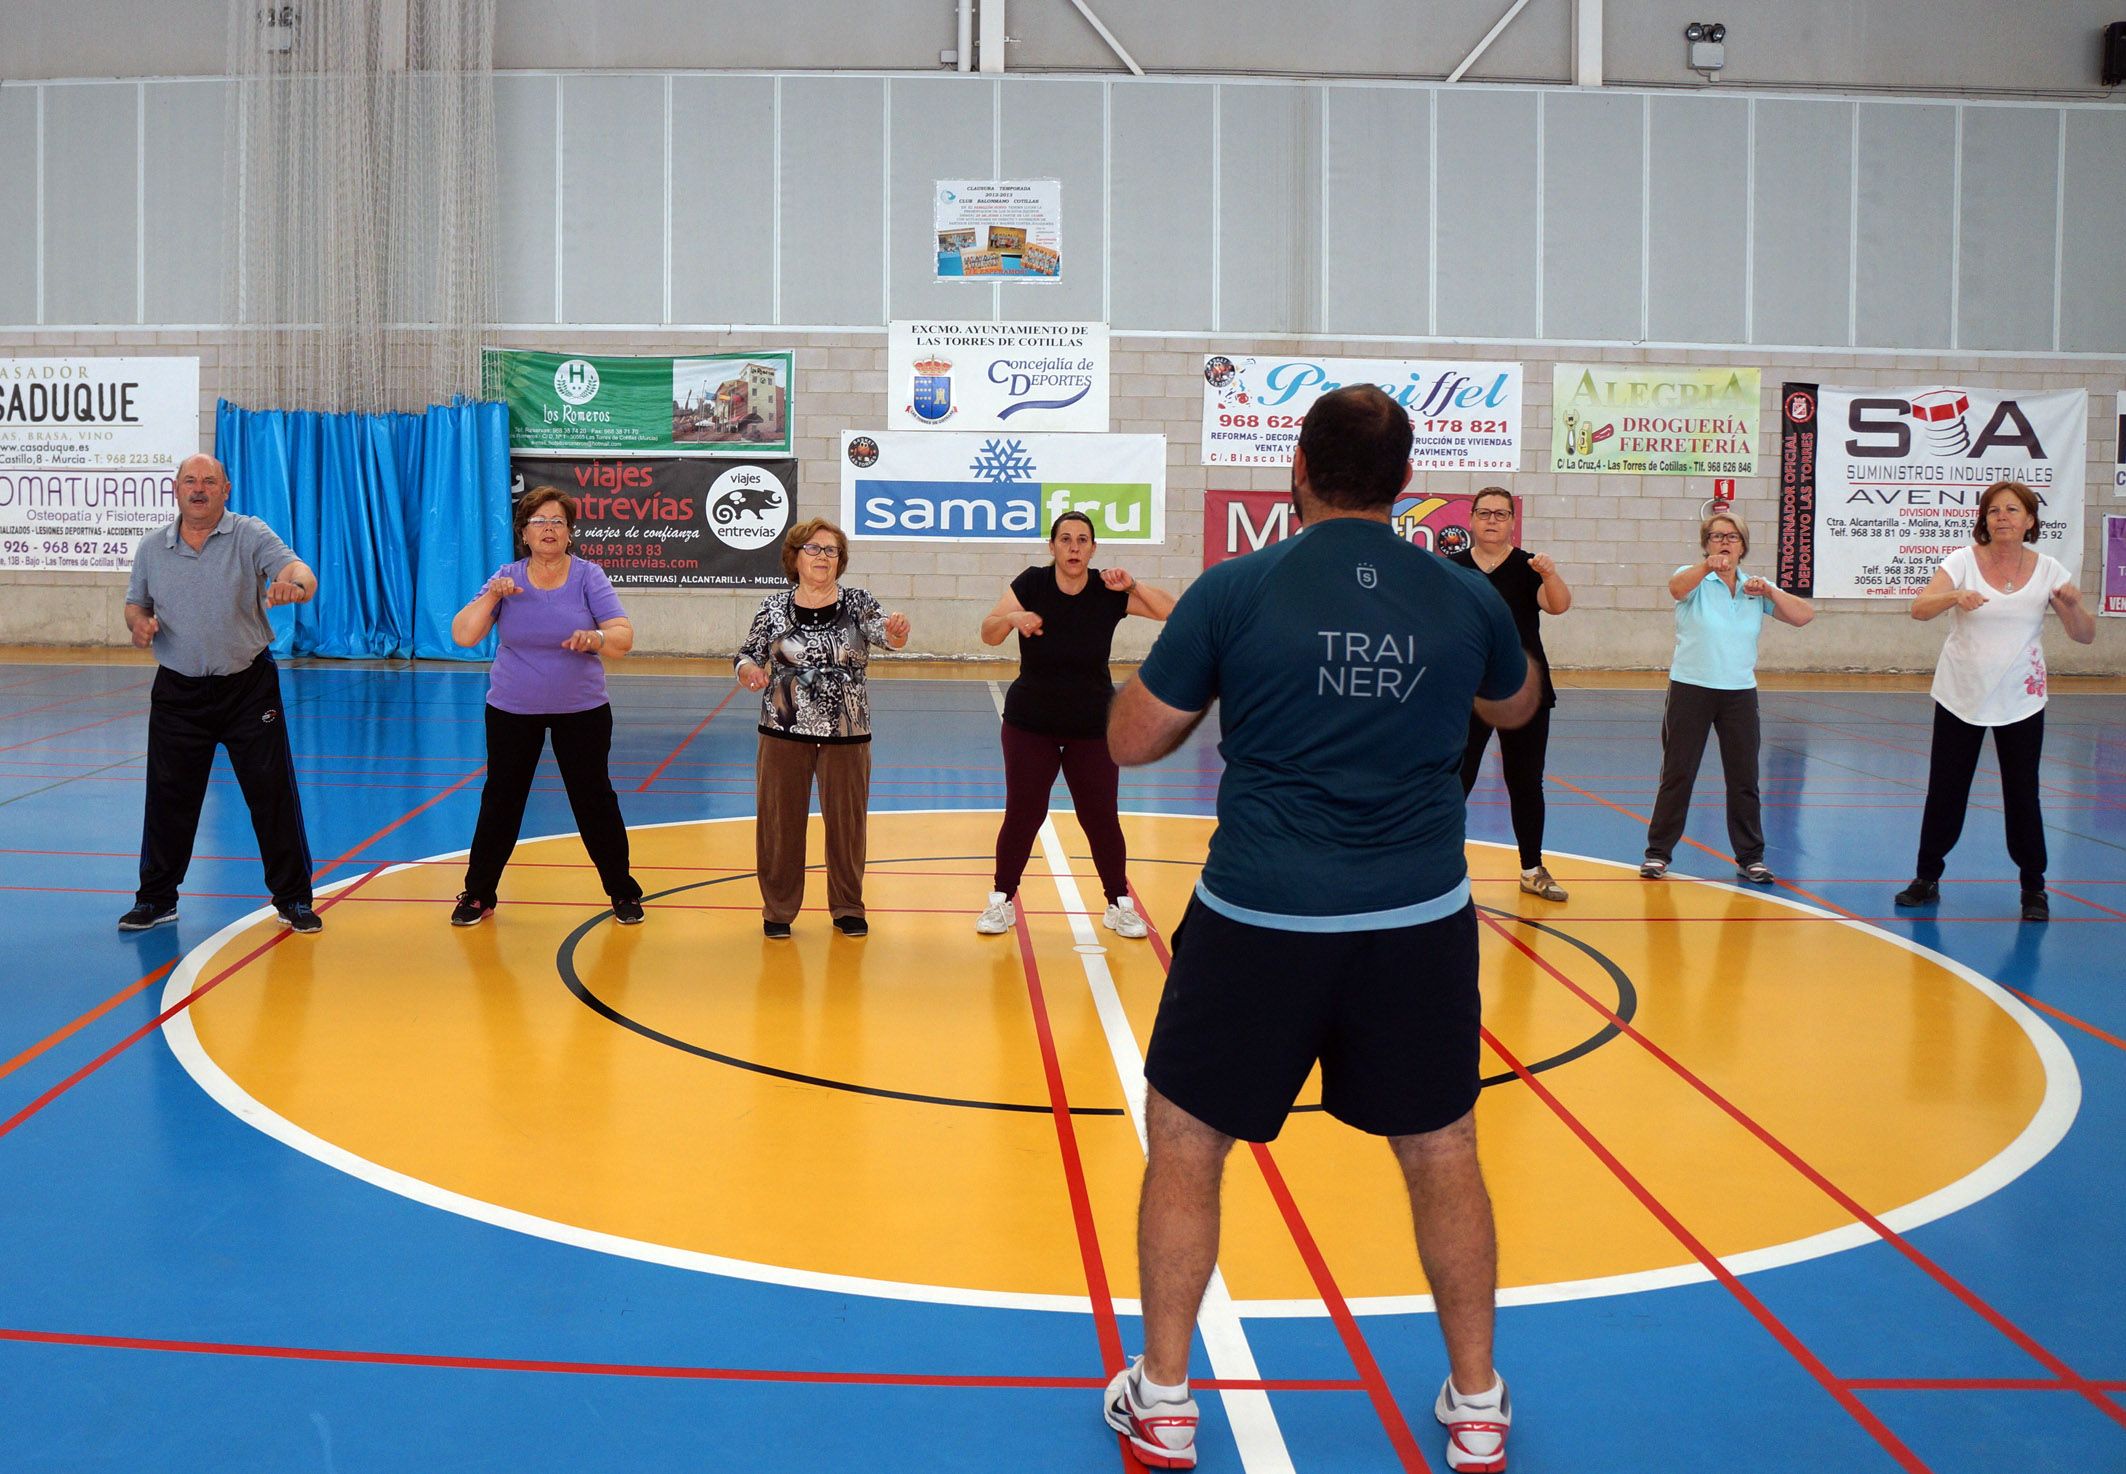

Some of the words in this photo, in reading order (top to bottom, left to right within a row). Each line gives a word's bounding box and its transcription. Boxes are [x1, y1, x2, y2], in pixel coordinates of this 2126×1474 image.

[911, 325, 962, 334] EXCMO.
[965, 325, 1069, 335] AYUNTAMIENTO
[1071, 326, 1089, 335] DE
[916, 336, 941, 346] LAS
[944, 337, 995, 346] TORRES
[998, 337, 1015, 347] DE
[1018, 338, 1083, 347] COTILLAS
[569, 364, 585, 383] H
[987, 357, 1073, 384] Concejalía
[1077, 358, 1094, 371] de
[1008, 373, 1093, 396] DEPORTES
[1572, 368, 1748, 408] ALEGRIA
[0, 382, 139, 422] ADUQUE
[543, 404, 559, 424] Los
[562, 404, 610, 424] Romeros
[1219, 414, 1259, 428] 968
[1424, 419, 1462, 432] 178
[1470, 420, 1507, 433] 821
[1622, 415, 1748, 434] DROGUERÍA
[28, 432, 72, 441] BRASA,
[80, 432, 113, 441] VINO
[1211, 432, 1257, 441] REFORMAS
[1265, 433, 1299, 441] DECORA
[1415, 435, 1453, 445] RUCCIÓN
[1454, 437, 1466, 445] DE
[1467, 438, 1513, 446] VIVIENDAS
[1255, 444, 1284, 452] VENTA
[1285, 444, 1291, 452] Y
[1414, 448, 1468, 456] PAVIMENTOS
[1619, 434, 1750, 454] FERRETERÍA
[52, 454, 85, 464] Murcia
[94, 454, 102, 464] T:
[106, 454, 125, 464] 968
[130, 454, 148, 464] 223
[153, 454, 173, 464] 584
[1459, 459, 1512, 468] Emisora
[1784, 432, 1797, 483] OFICIAL
[1800, 432, 1814, 482] TORRES
[1557, 459, 1565, 469] C/
[1567, 459, 1576, 469] La
[1607, 460, 1621, 470] Las
[1623, 460, 1646, 470] Torres
[1648, 461, 1657, 471] de
[1659, 461, 1687, 471] Cotillas
[1707, 462, 1720, 472] 968
[1723, 462, 1736, 472] 626
[1738, 463, 1752, 473] 846
[574, 461, 654, 494] viajes
[730, 473, 761, 486] viajes
[1847, 465, 1944, 480] SUMINISTROS
[1950, 466, 2053, 482] INDUSTRIALES
[1800, 484, 1812, 510] LAS
[1846, 489, 2048, 506] AVENIA
[571, 491, 694, 520] ntrevías
[27, 509, 92, 523] Osteopatía
[95, 513, 103, 523] y
[106, 511, 175, 523] Fisioterapia
[1900, 508, 1939, 517] DIVISION
[1943, 508, 1980, 518] INDUSTR
[1826, 518, 1846, 527] Ctra.
[1849, 518, 1899, 527] Alcantarilla
[1909, 518, 1941, 529] Molina,
[1944, 519, 1975, 529] Km.8,5
[2040, 520, 2067, 529] Pedro
[35, 526, 64, 535] LESIONES
[65, 526, 102, 535] DEPORTIVAS
[107, 527, 144, 536] ACCIDENTES
[584, 526, 621, 541] viajes
[624, 525, 640, 538] de
[643, 525, 701, 542] confianza
[718, 525, 776, 538] entrevías
[1781, 485, 1796, 588] PATROCINADOR
[1830, 528, 1847, 536] Telf.
[1851, 528, 1868, 537] 968
[1870, 529, 1882, 537] 38
[1884, 529, 1895, 537] 81
[1899, 529, 1911, 537] 09
[1919, 529, 1936, 537] 938
[1939, 529, 1951, 537] 38
[1953, 529, 1963, 537] 81
[2051, 530, 2063, 539] 92
[4, 540, 29, 553] 926
[43, 541, 69, 554] 968
[74, 542, 98, 554] 627
[103, 542, 128, 554] 245
[626, 544, 643, 556] 83
[646, 544, 662, 556] 83
[1798, 513, 1812, 588] DEPORTIVO
[1899, 545, 1939, 554] DIVISION
[25, 556, 39, 568] Bajo
[45, 556, 57, 566] Las
[58, 557, 78, 566] Torres
[80, 557, 88, 566] de
[90, 557, 114, 567] Cotillas
[586, 556, 698, 569] esentrevias.com
[1892, 556, 1906, 564] Av.
[1909, 556, 1923, 564] Los
[1862, 566, 1881, 574] Telf.
[1884, 566, 1901, 574] 968
[1903, 566, 1915, 574] 38
[1918, 567, 1928, 575] 75
[627, 575, 677, 584] ENTREVIAS)
[681, 576, 746, 584] ALCANTARILLA
[754, 577, 788, 585] MURCIA
[1363, 573, 1372, 583] S
[1854, 576, 1882, 584] 30565
[1885, 576, 1901, 584] LAS
[1904, 576, 1931, 585] TORRE
[1866, 586, 1896, 595] e-mail:
[1899, 586, 1924, 596] info@
[1317, 631, 1414, 664] TRAI
